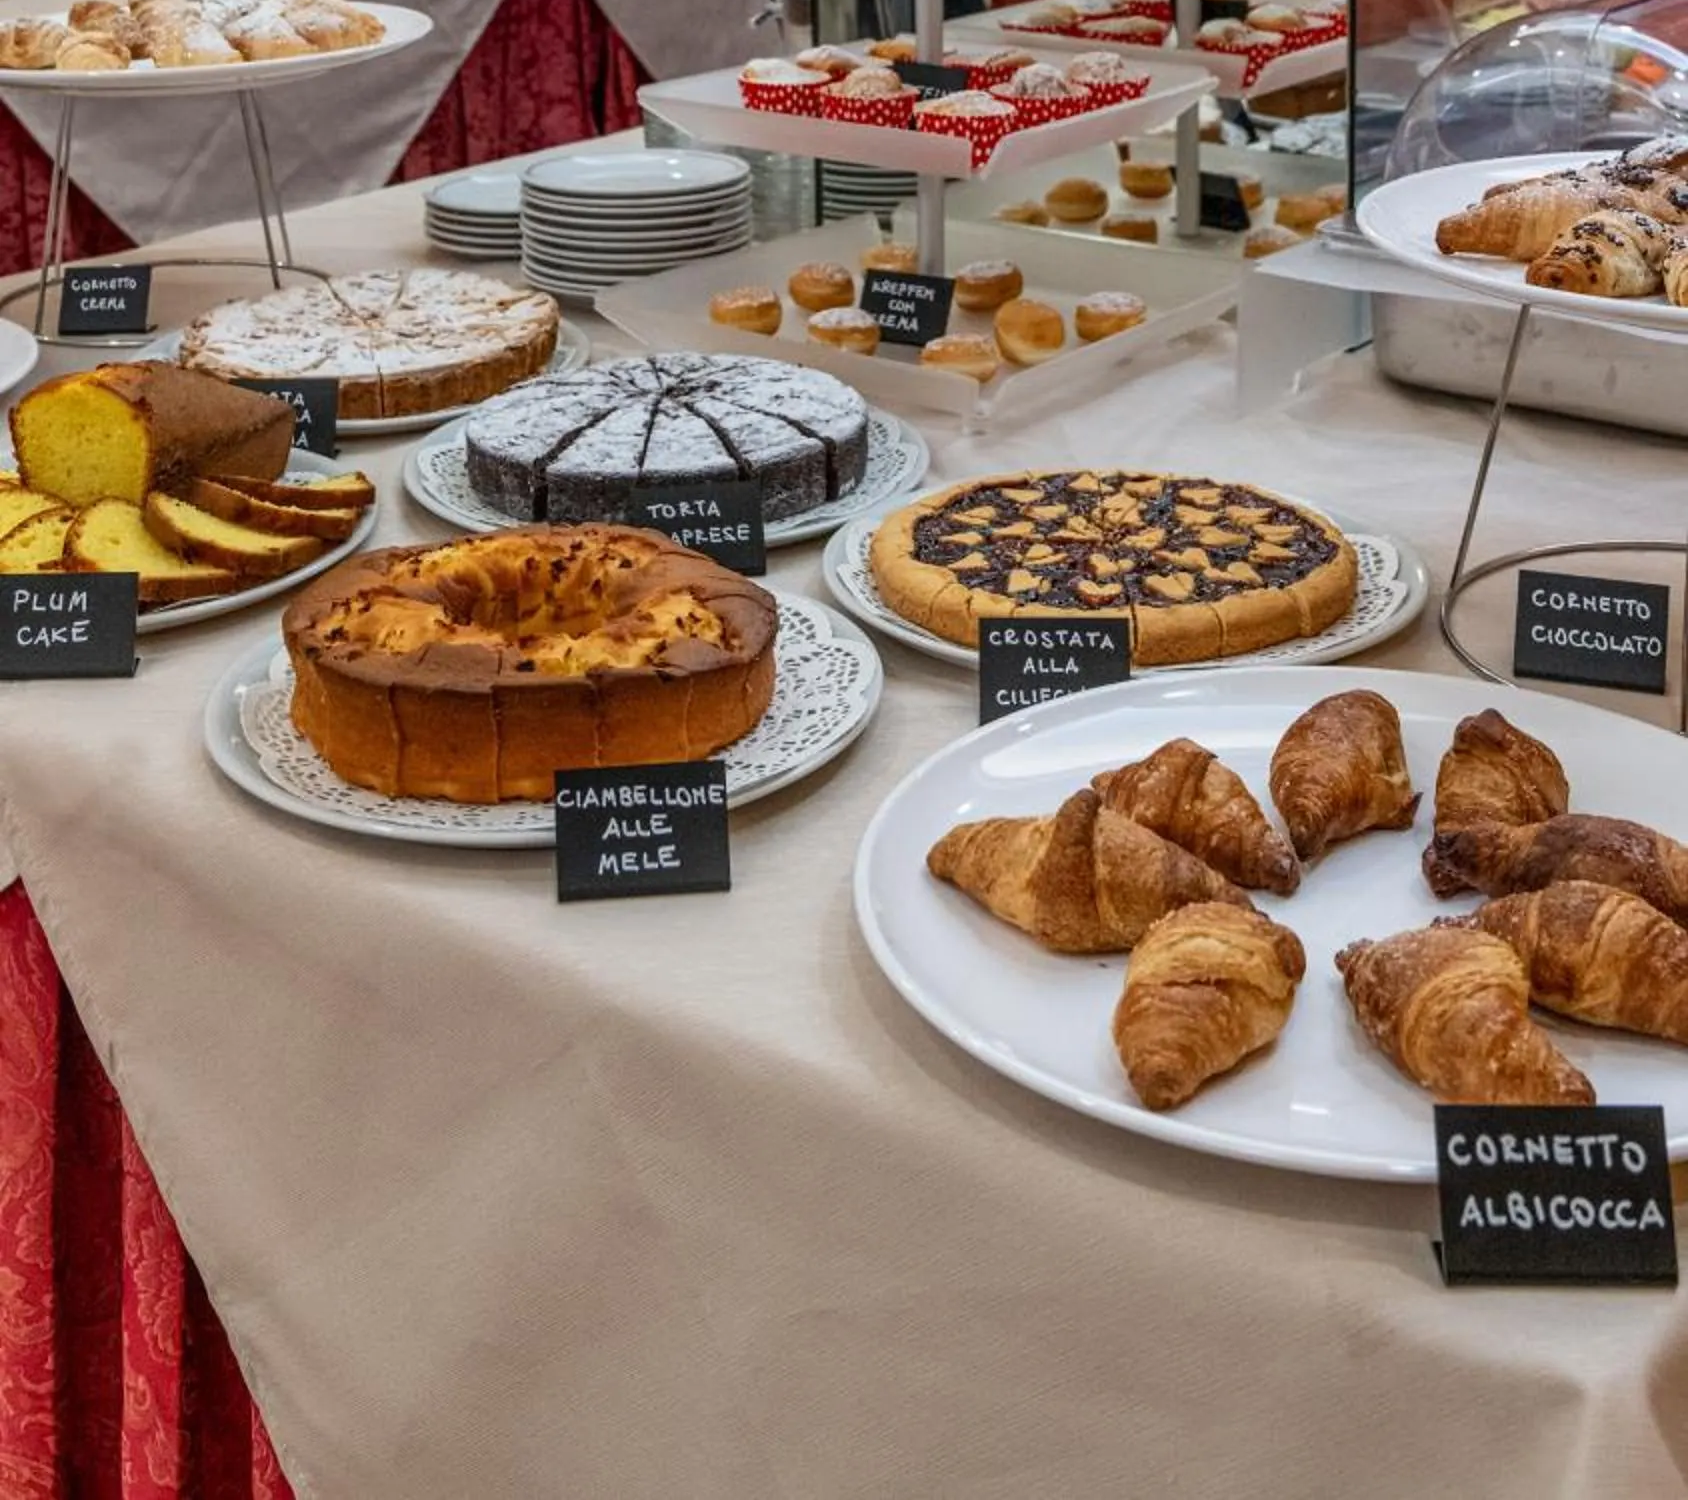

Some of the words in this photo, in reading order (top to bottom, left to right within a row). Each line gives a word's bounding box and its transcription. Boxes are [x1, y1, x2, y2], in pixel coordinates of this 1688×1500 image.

[71, 277, 137, 291] CORNETTO
[80, 297, 126, 311] CREMA
[888, 299, 916, 314] CON
[873, 313, 919, 332] REMA
[646, 500, 721, 519] TORTA
[670, 523, 751, 547] APRESE
[13, 588, 87, 612] PLUM
[1531, 589, 1651, 620] CORNETTO
[16, 619, 91, 648] CAKE
[989, 628, 1115, 650] CROSTATA
[1531, 625, 1662, 656] CIOCCOLATO
[1023, 656, 1080, 675] ALLA
[557, 784, 725, 809] CIAMBELLONE
[601, 813, 673, 841] ALLE
[598, 844, 681, 876] MELE
[1447, 1133, 1647, 1174] CORNETTO
[1460, 1190, 1666, 1230] ALBICOCCA
